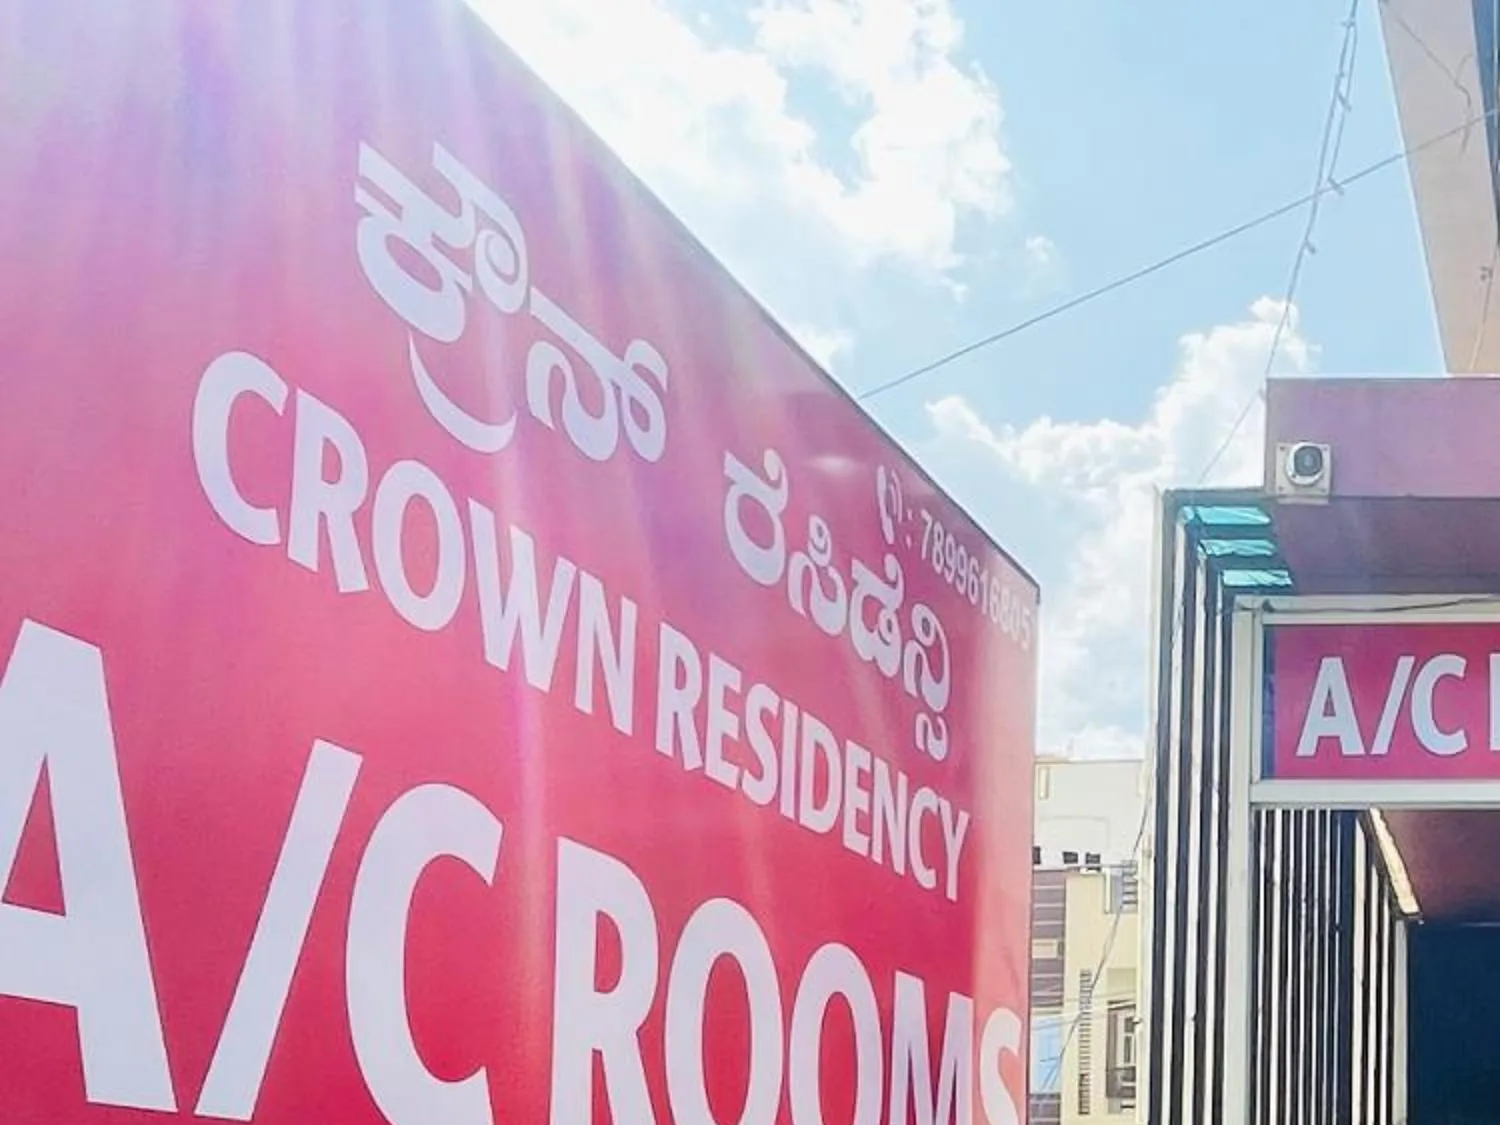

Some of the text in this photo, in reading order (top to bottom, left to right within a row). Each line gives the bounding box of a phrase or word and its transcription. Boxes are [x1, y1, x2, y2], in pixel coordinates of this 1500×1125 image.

[192, 350, 972, 901] CROWN RESIDENCY
[723, 448, 951, 761] ರೆಸಿಡೆನ್ಸಿ
[1296, 653, 1469, 757] A/C
